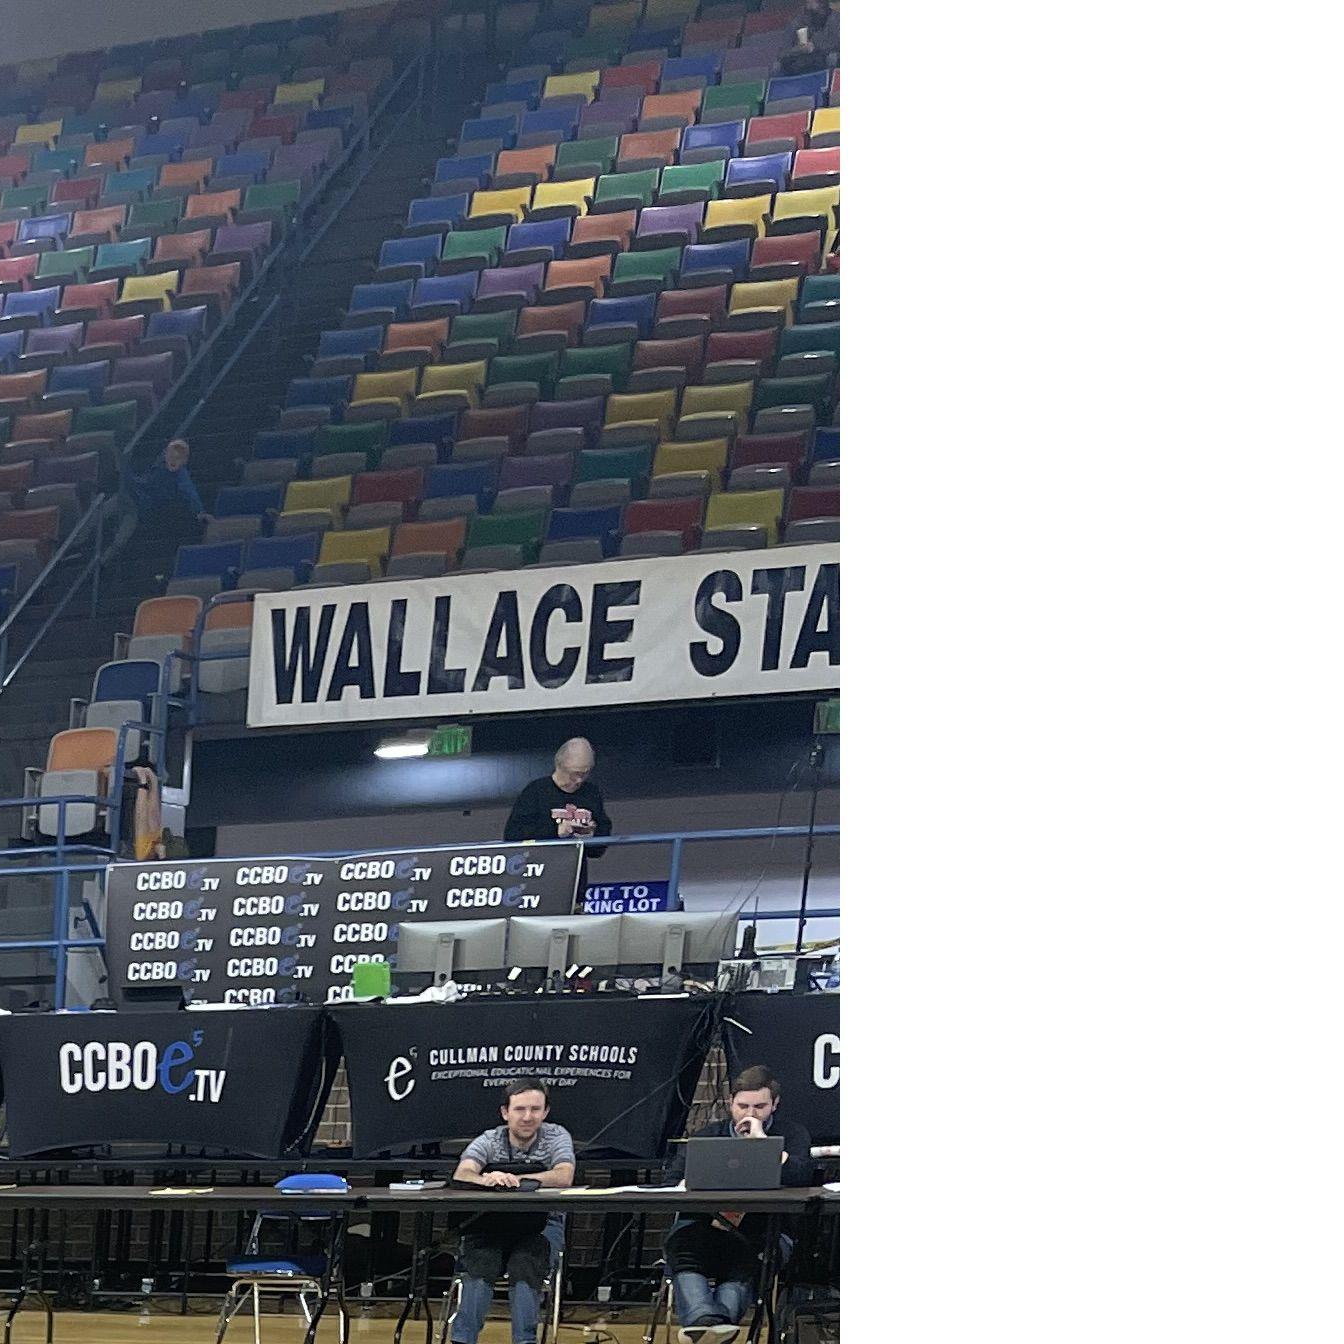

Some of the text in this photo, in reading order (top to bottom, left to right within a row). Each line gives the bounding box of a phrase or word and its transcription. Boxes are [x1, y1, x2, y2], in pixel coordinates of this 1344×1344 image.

[271, 579, 641, 706] WALLACE
[620, 884, 649, 899] TO
[583, 898, 662, 915] KING LOT
[429, 1044, 638, 1066] CULLMAN COUNTY SCHOOLS
[431, 1068, 489, 1081] EXCEPTIONAL
[554, 1067, 611, 1080] EXPERIENCES
[613, 1070, 632, 1080] FOR
[559, 1077, 578, 1088] DAY
